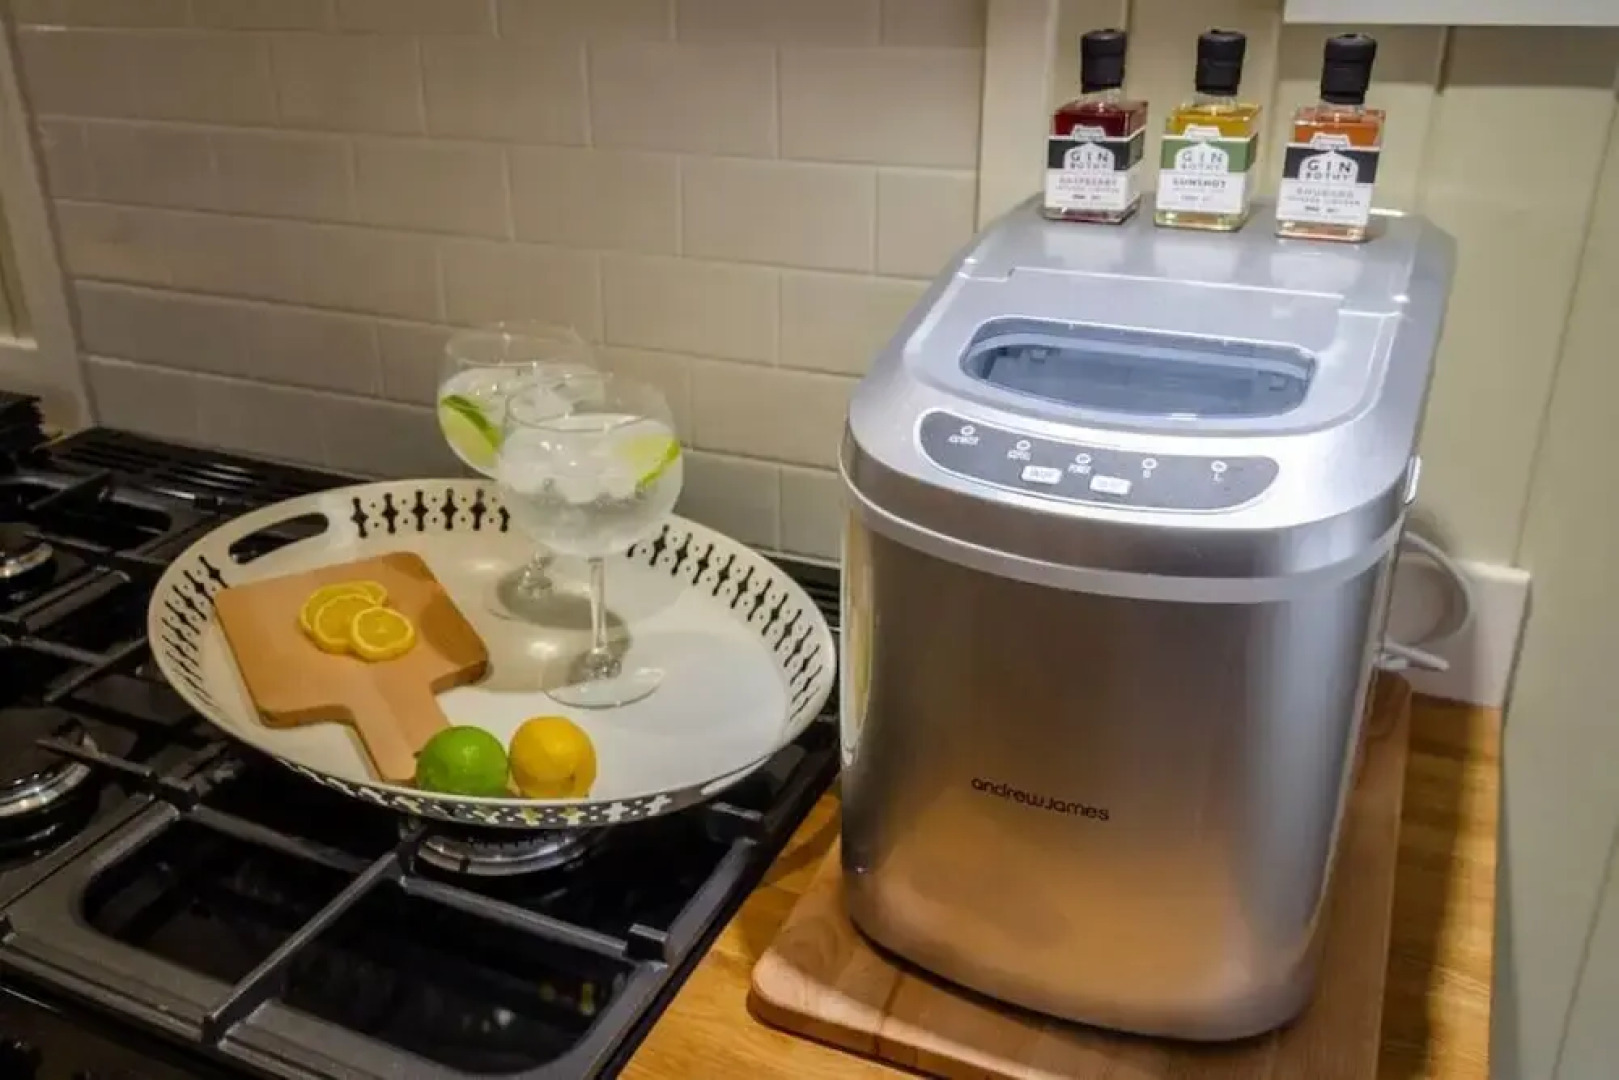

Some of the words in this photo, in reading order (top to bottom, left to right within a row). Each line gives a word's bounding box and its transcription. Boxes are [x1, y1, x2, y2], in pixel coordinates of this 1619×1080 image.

[1071, 151, 1108, 162] GIN
[1182, 151, 1223, 162] GIN
[1307, 160, 1352, 172] GIN
